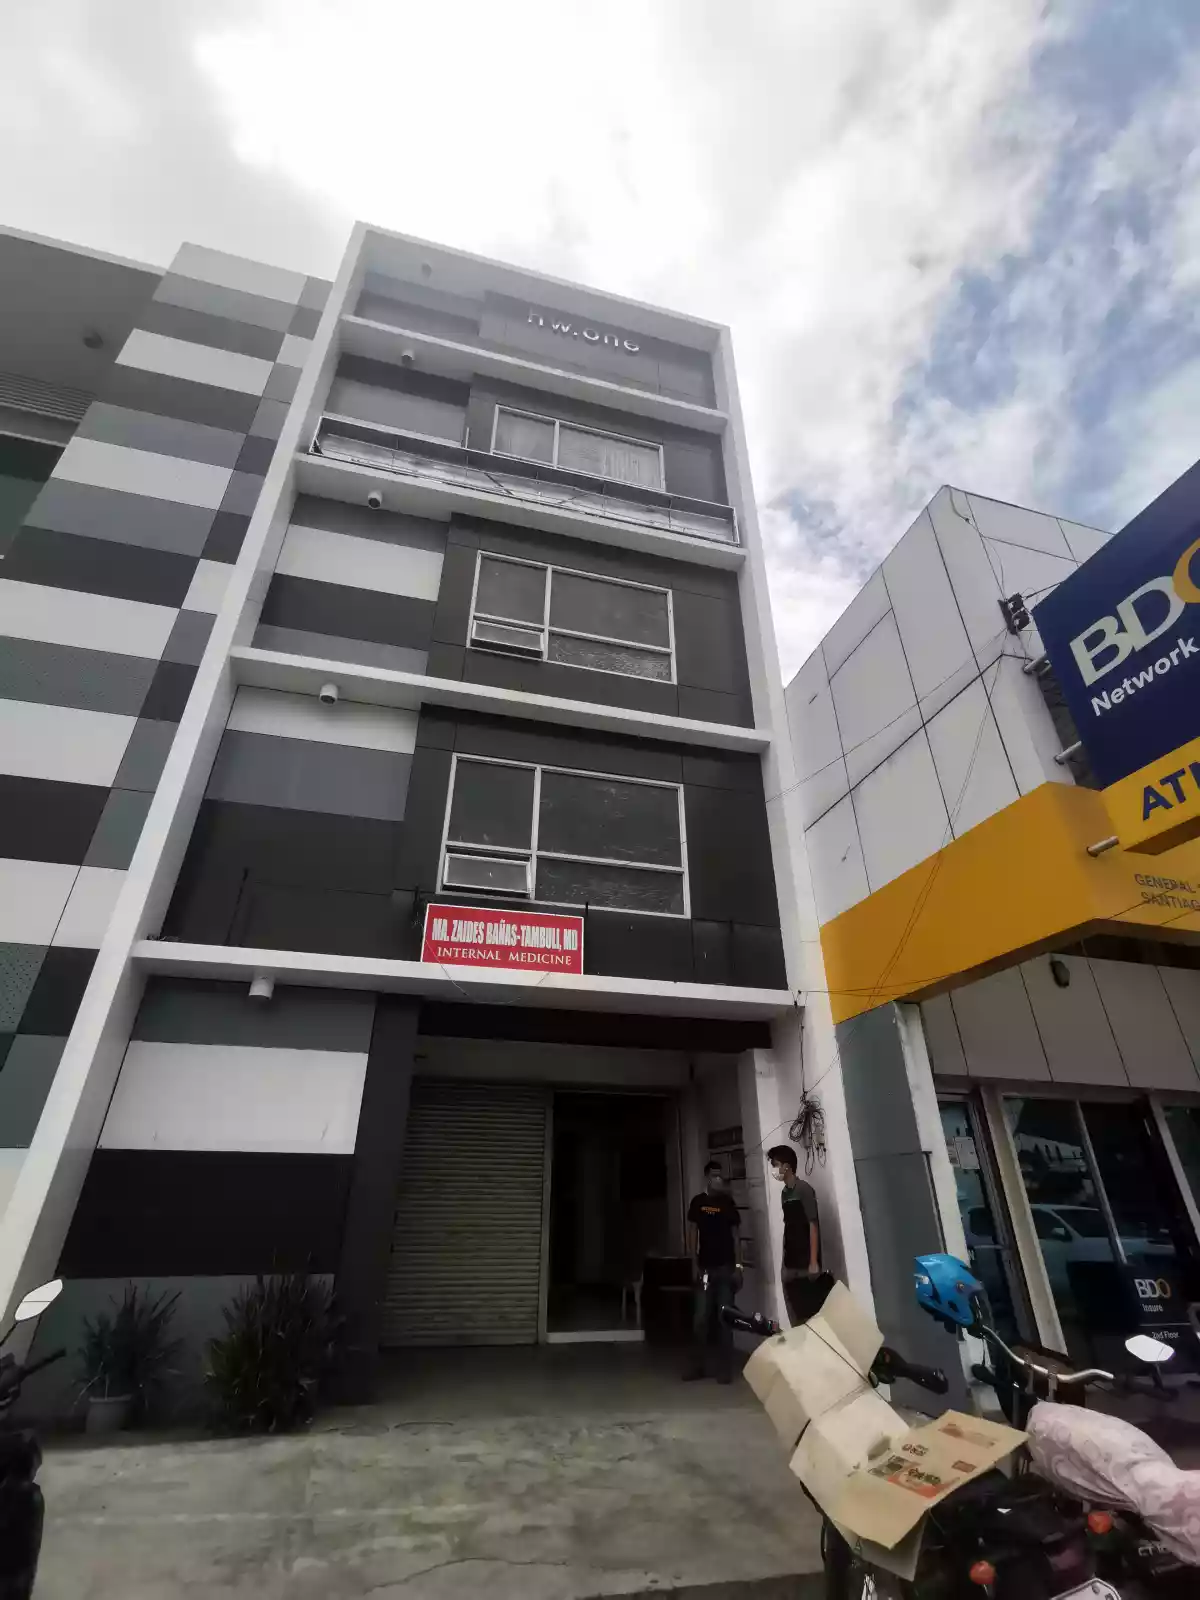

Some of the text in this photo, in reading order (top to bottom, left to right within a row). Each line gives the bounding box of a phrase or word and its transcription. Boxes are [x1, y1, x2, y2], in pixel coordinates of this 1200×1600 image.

[1091, 636, 1200, 717] Network
[1134, 873, 1196, 893] GENERAL
[451, 919, 484, 944] ZAIDES
[563, 929, 578, 951] MD
[437, 946, 572, 966] INTERNAL MEDICINE
[1134, 1278, 1172, 1298] BDO
